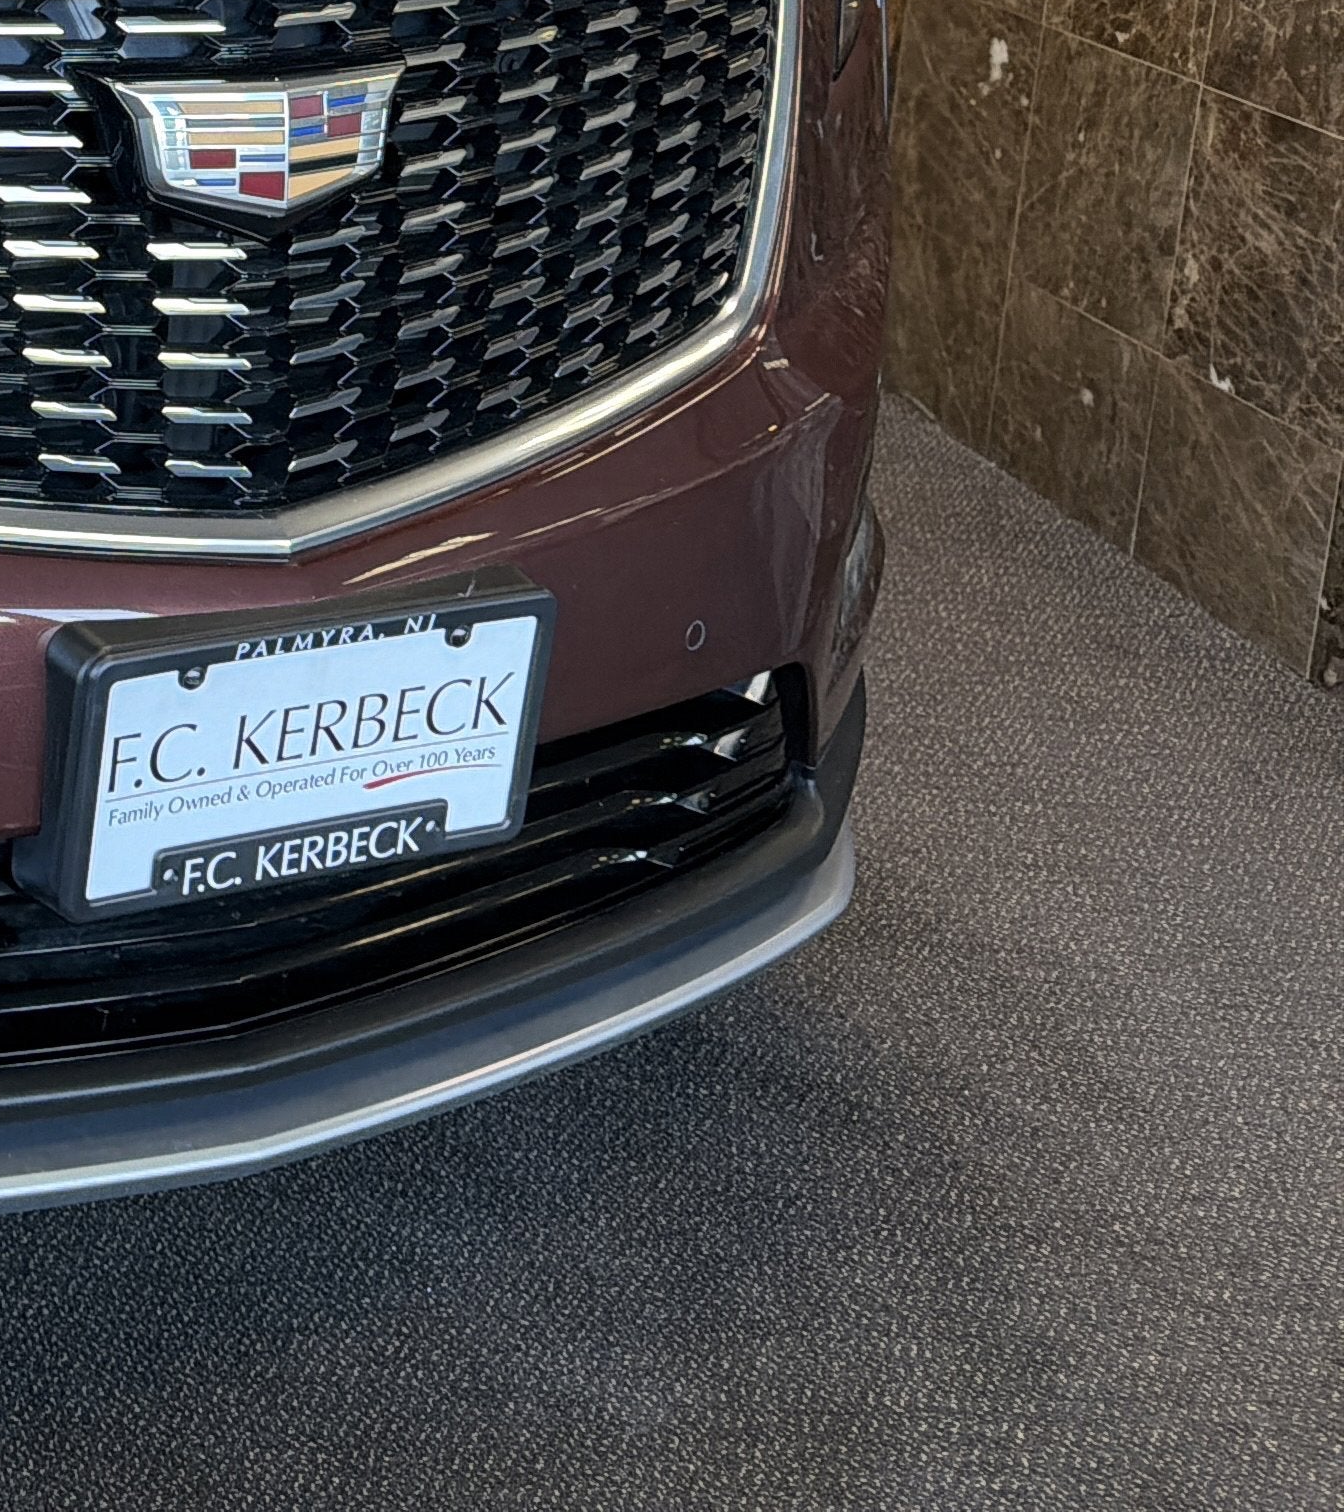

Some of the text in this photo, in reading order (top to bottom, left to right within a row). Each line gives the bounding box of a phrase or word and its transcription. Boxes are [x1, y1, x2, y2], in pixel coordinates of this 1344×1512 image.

[234, 623, 385, 662] PALMYRA,
[107, 671, 515, 794] F.C. KERBECK
[108, 744, 496, 827] Family Owned & Operated For Over 100 Years
[181, 816, 424, 896] F.C. KERBECK
